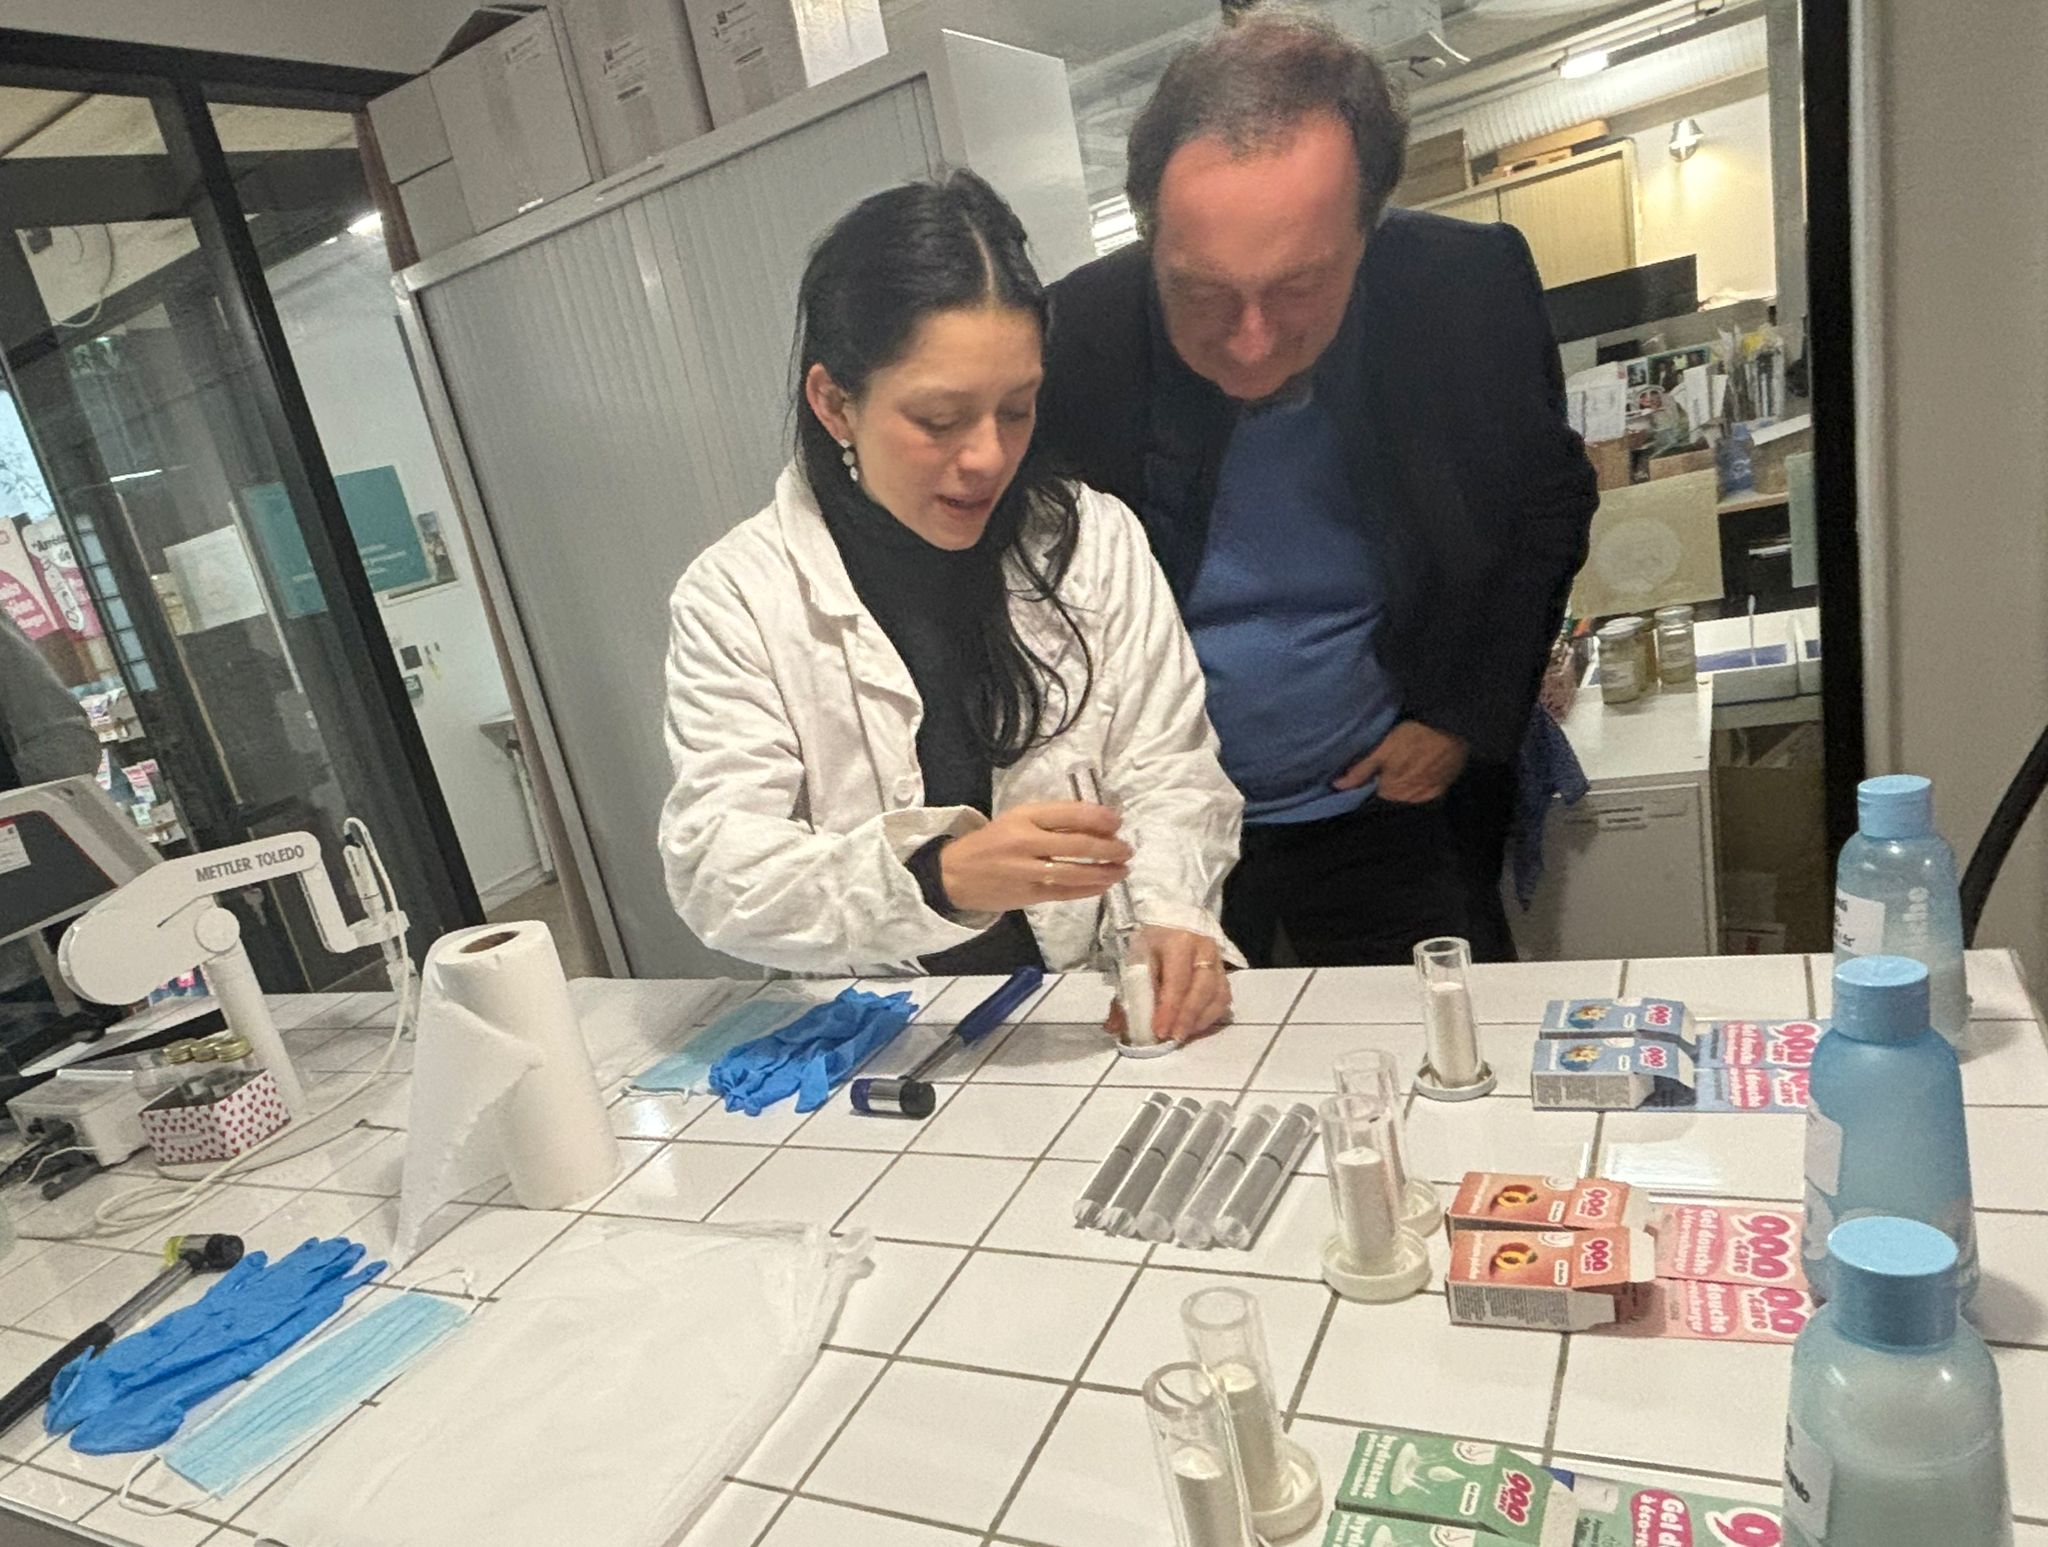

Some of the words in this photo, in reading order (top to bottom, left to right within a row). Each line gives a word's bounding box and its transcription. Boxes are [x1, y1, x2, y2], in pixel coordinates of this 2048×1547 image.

[195, 857, 252, 882] METTLER
[255, 845, 304, 868] TOLEDO
[1699, 1209, 1719, 1229] Gel
[1585, 1239, 1609, 1272] 900
[1693, 1229, 1716, 1275] douche
[1732, 1239, 1751, 1274] .care
[1737, 1215, 1791, 1278] 900
[1705, 1283, 1729, 1333] douche
[1747, 1293, 1768, 1329] .care
[1759, 1287, 1807, 1333] 00
[1362, 1435, 1399, 1499] hydratant
[1506, 1472, 1532, 1523] 900
[1641, 1494, 1658, 1503] à
[1658, 1498, 1685, 1531] Gel
